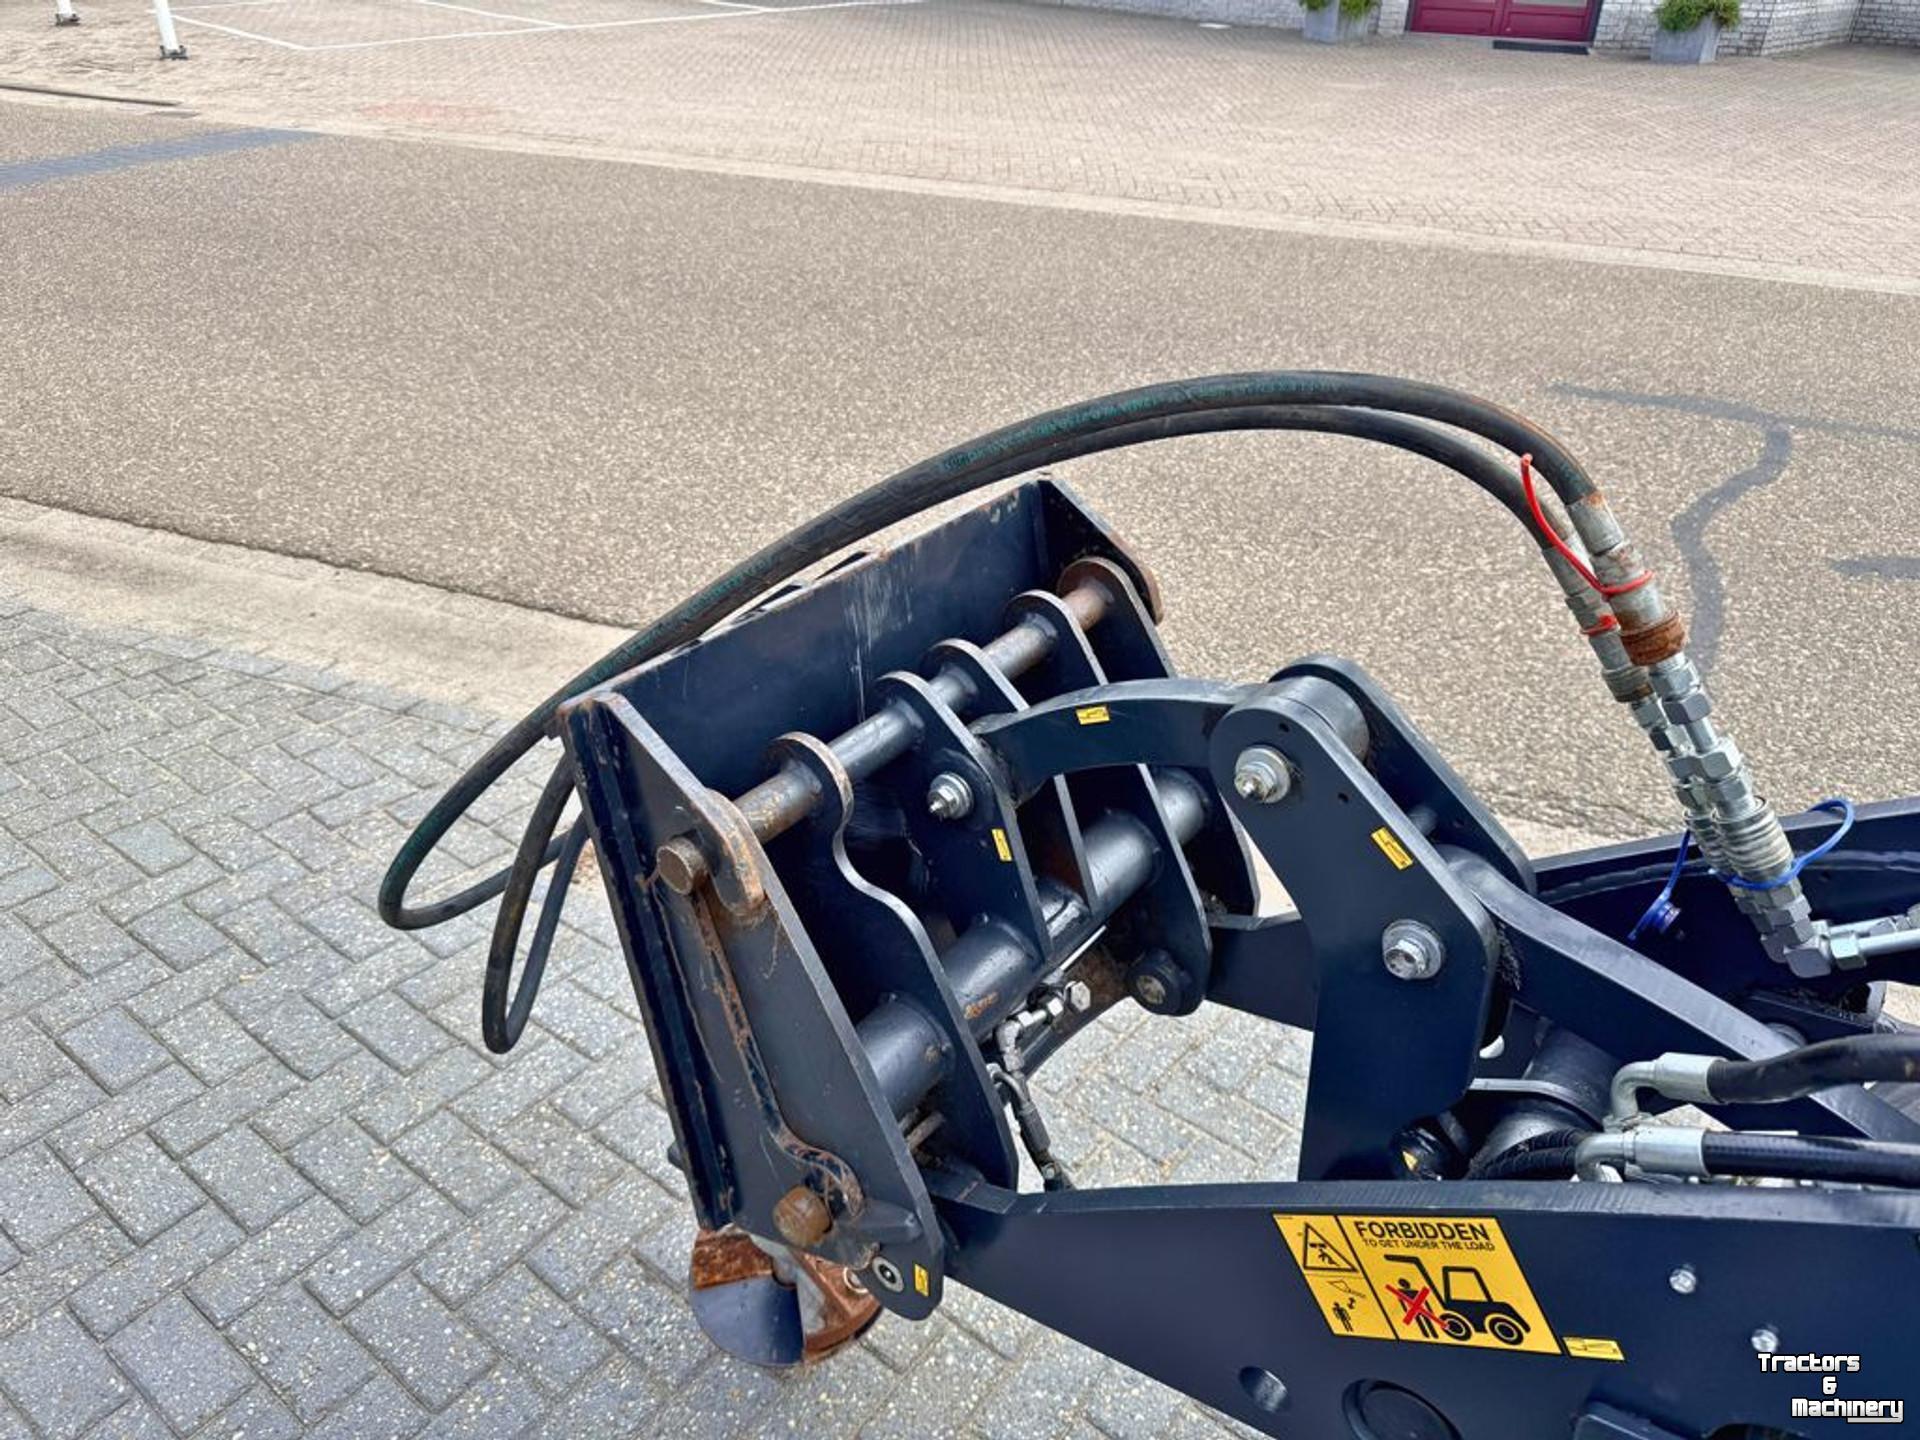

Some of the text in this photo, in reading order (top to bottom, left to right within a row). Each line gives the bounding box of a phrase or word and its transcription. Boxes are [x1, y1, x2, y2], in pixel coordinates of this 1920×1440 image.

[1354, 1221, 1490, 1241] FORBIDDEN
[1362, 1239, 1495, 1251] TO GET UNDER THE LOAD
